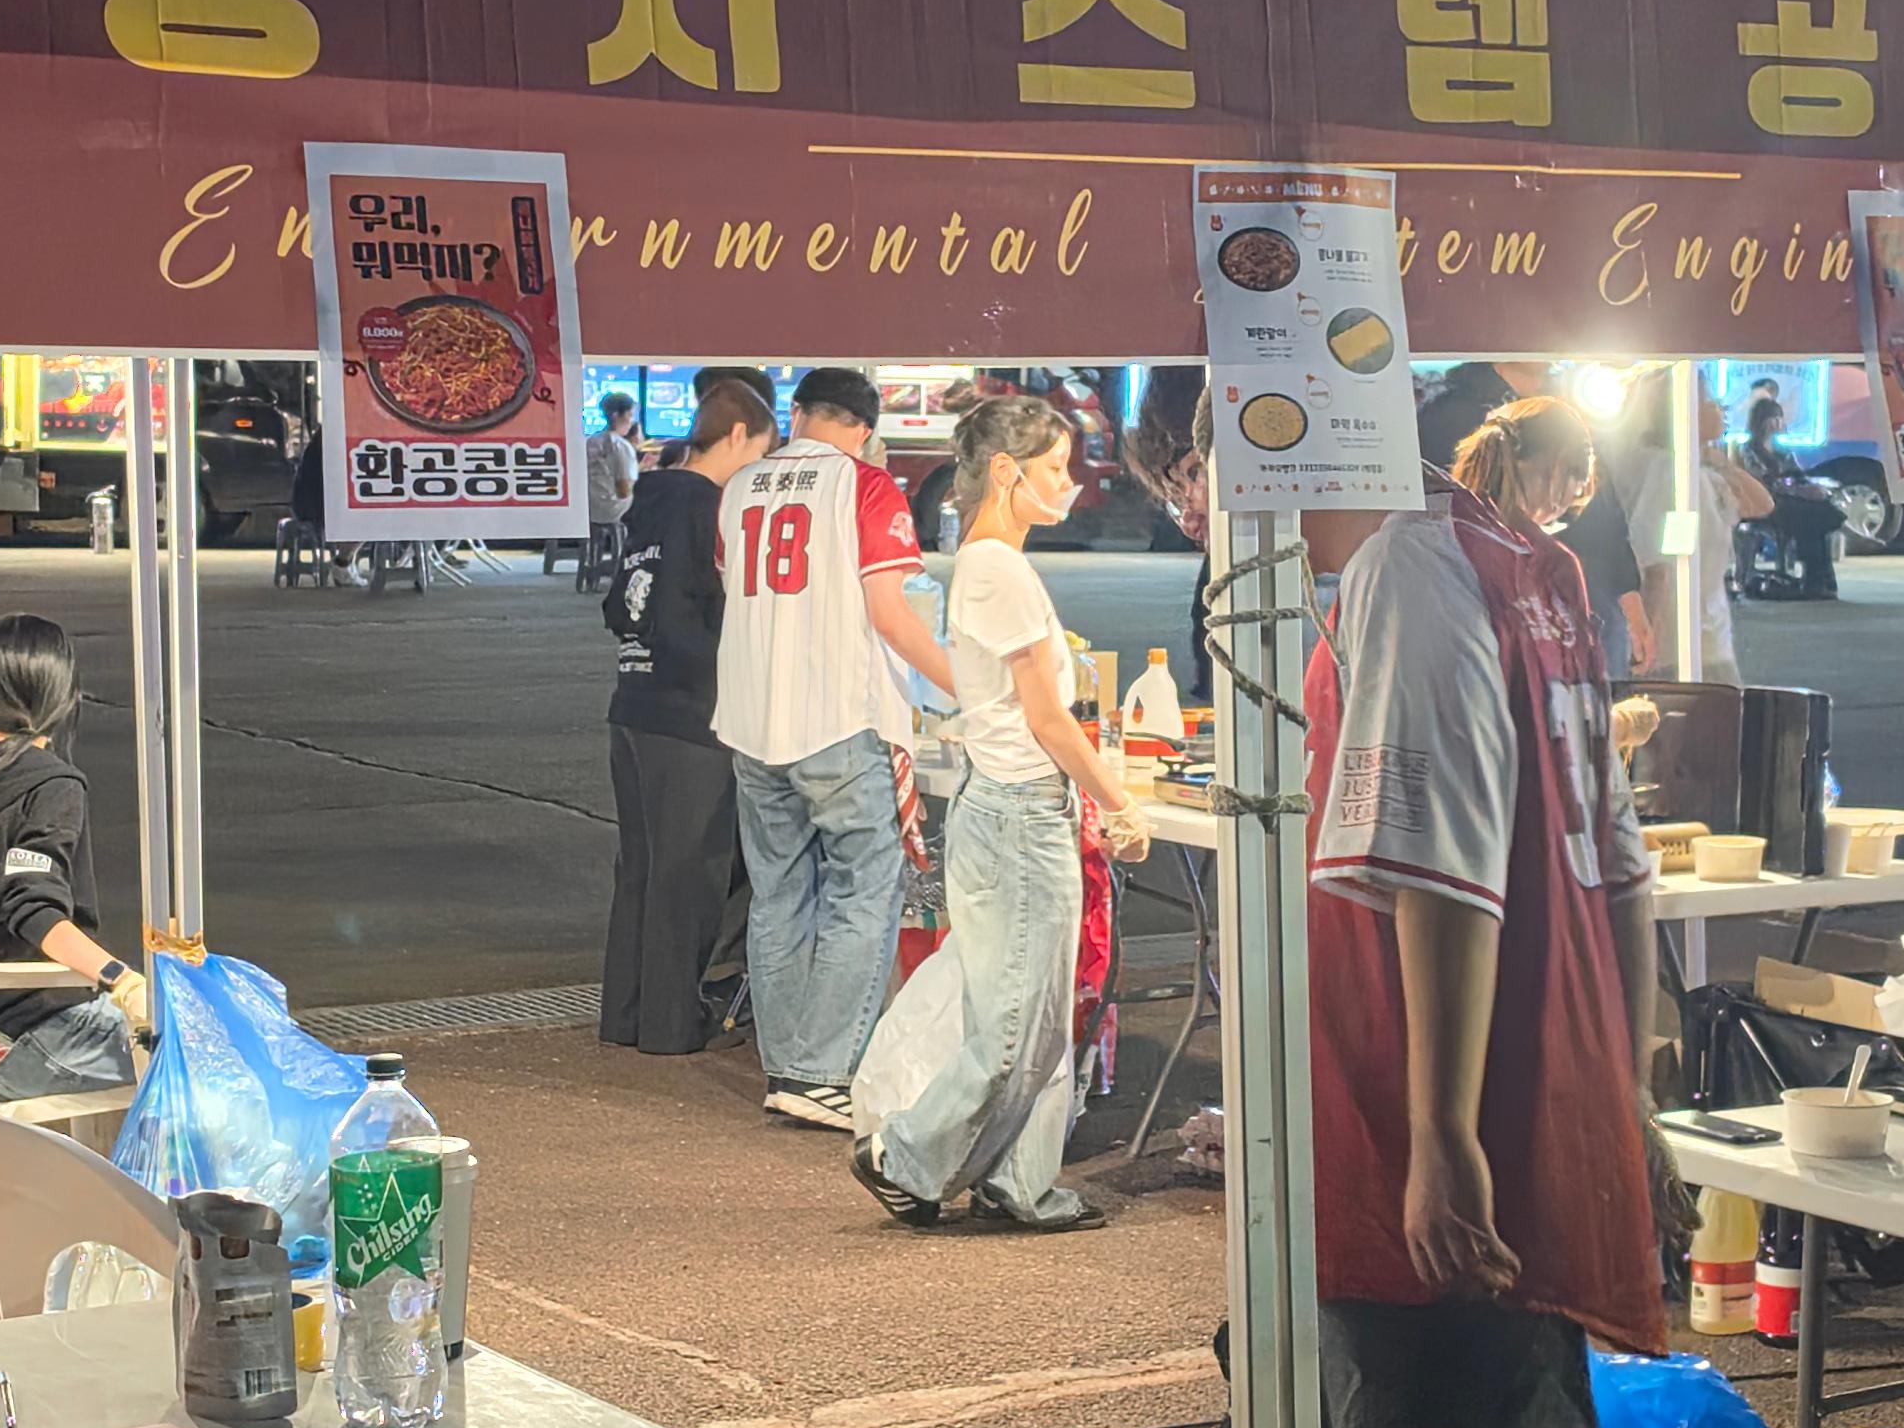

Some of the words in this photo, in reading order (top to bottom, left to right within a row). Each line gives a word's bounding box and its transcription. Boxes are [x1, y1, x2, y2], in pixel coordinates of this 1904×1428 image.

[1283, 180, 1324, 197] MENU
[349, 194, 441, 237] 우리,
[354, 444, 560, 498] 환공콩불
[742, 503, 812, 598] 18
[347, 1194, 434, 1272] Chilsung
[382, 1228, 420, 1262] CIDER
